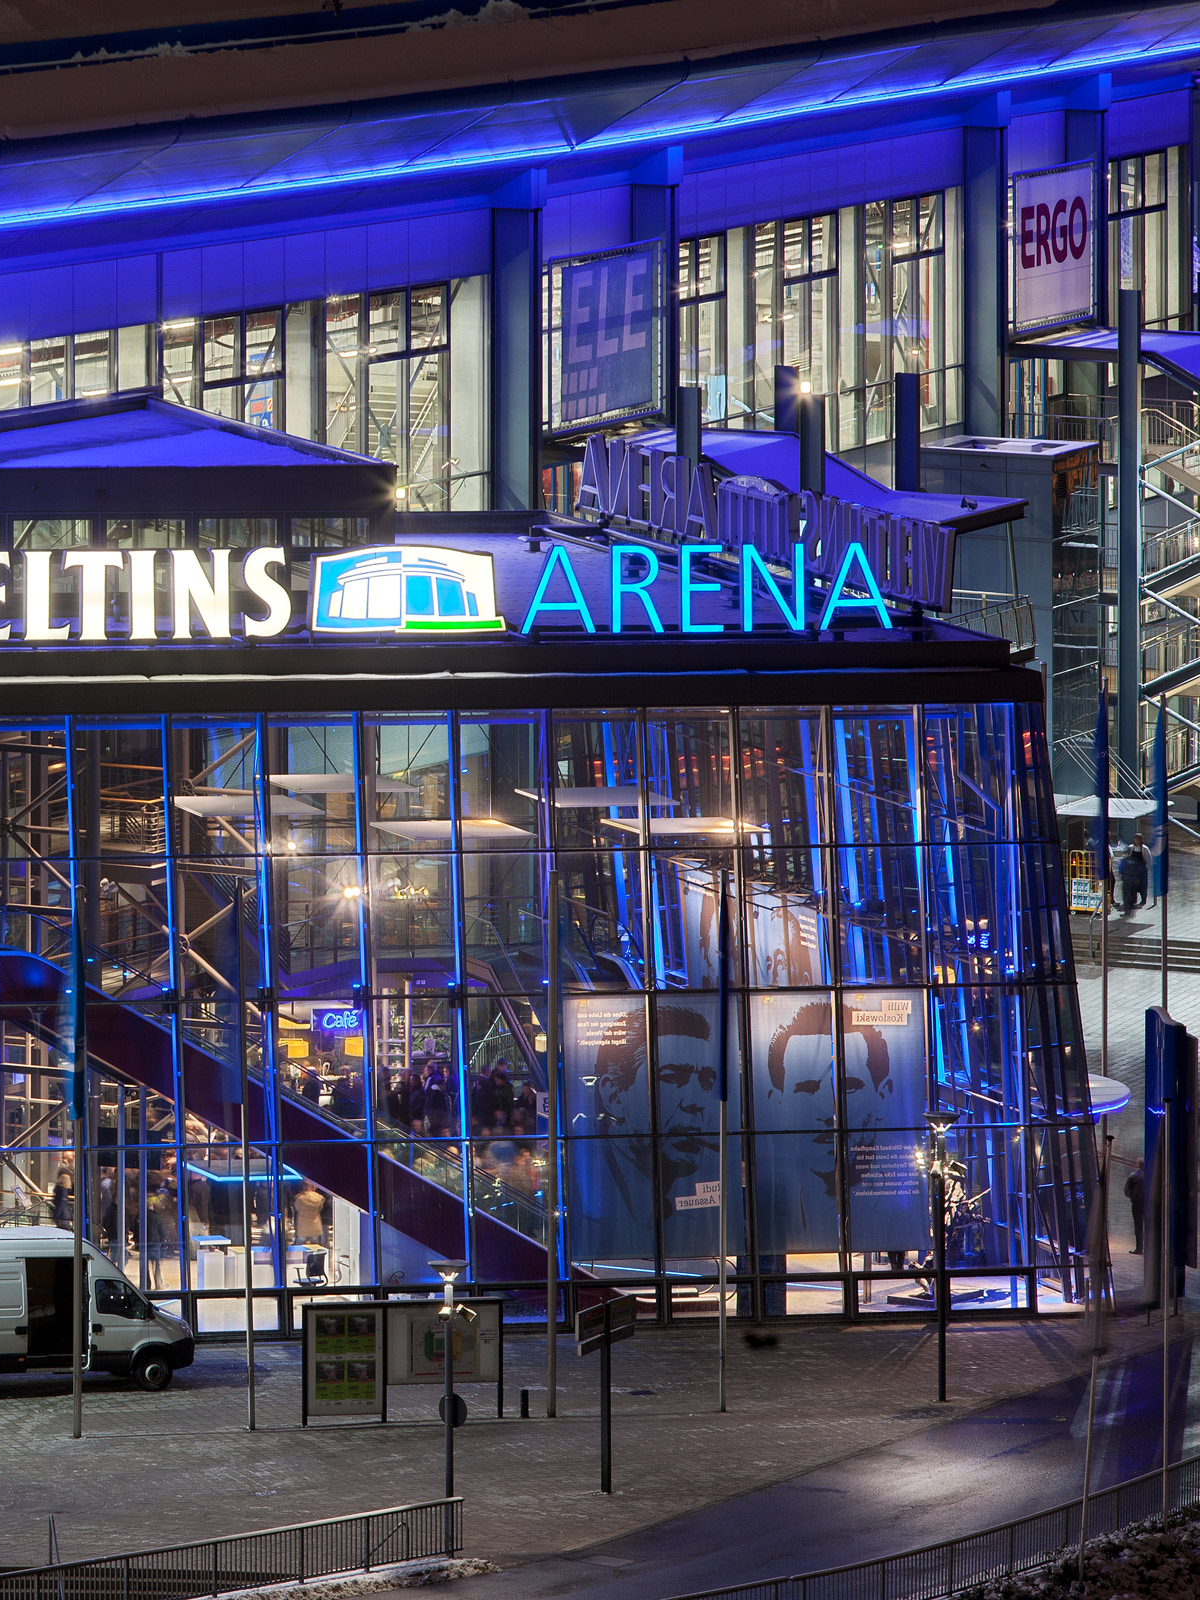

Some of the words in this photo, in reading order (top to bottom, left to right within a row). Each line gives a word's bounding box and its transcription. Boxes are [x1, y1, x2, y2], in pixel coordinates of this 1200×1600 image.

[1021, 196, 1087, 269] ERGO
[568, 258, 647, 364] ELE
[521, 542, 893, 634] ARENA
[322, 1009, 359, 1030] Café
